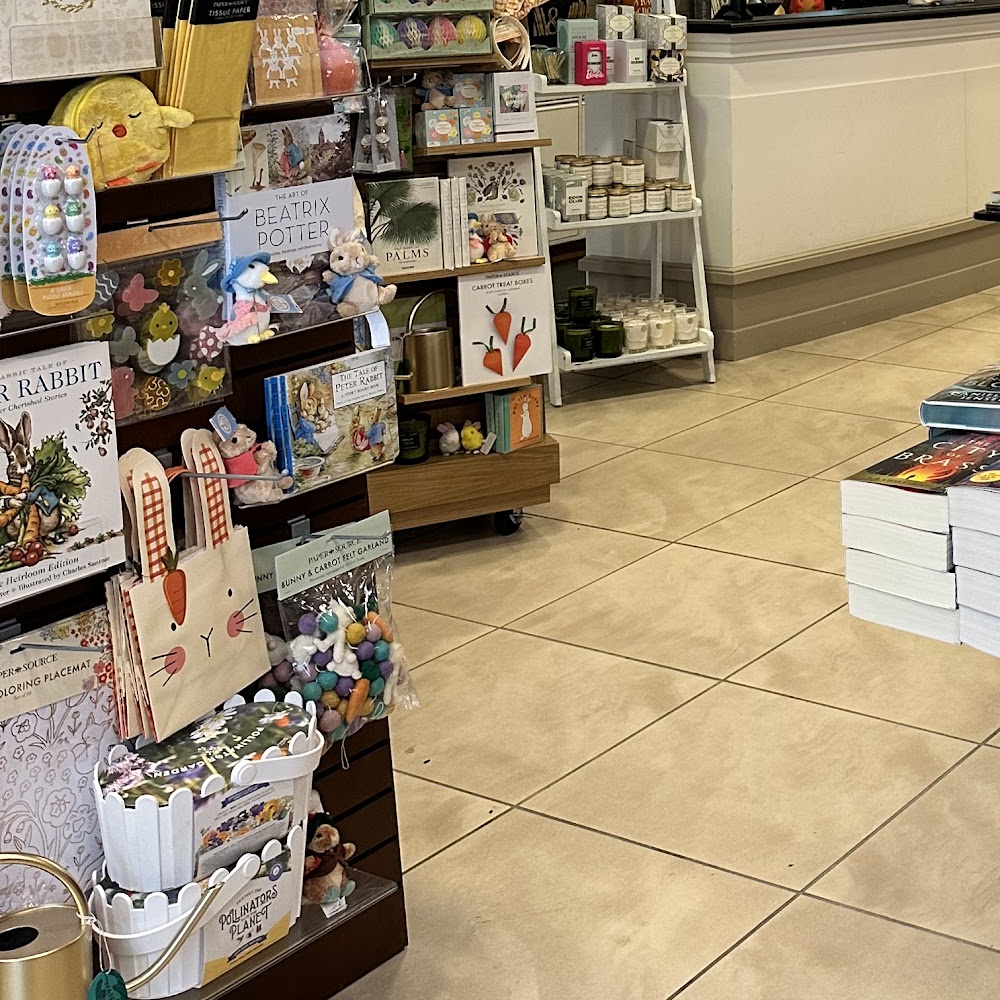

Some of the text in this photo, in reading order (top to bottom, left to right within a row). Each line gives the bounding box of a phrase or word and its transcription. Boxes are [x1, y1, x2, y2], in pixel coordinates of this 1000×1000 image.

[209, 6, 250, 16] TISSUE PAPER
[288, 191, 300, 199] ART
[254, 197, 330, 227] BEATRIX
[258, 220, 330, 250] POTTER
[386, 248, 430, 262] PALMS
[472, 283, 495, 291] CARROT
[0, 369, 28, 380] ASSIC
[31, 364, 54, 373] TALE
[18, 361, 102, 398] RABBIT
[336, 372, 384, 392] PETER RABBIT
[354, 368, 369, 377] TALE
[8, 392, 68, 412] Cherished Stories
[6, 557, 80, 586] Heirloom Edition
[281, 572, 306, 588] BUNNY
[314, 556, 341, 574] CARROT
[342, 551, 356, 562] FELT
[357, 538, 389, 555] GARLAND
[18, 576, 52, 592] Illustrated
[62, 564, 86, 576] Charles
[22, 653, 58, 672] SOURCE
[44, 660, 91, 682] PLACEMAT
[153, 761, 205, 778] GARDEN
[219, 884, 278, 930] POLLINATORS
[230, 902, 272, 940] PLANET
